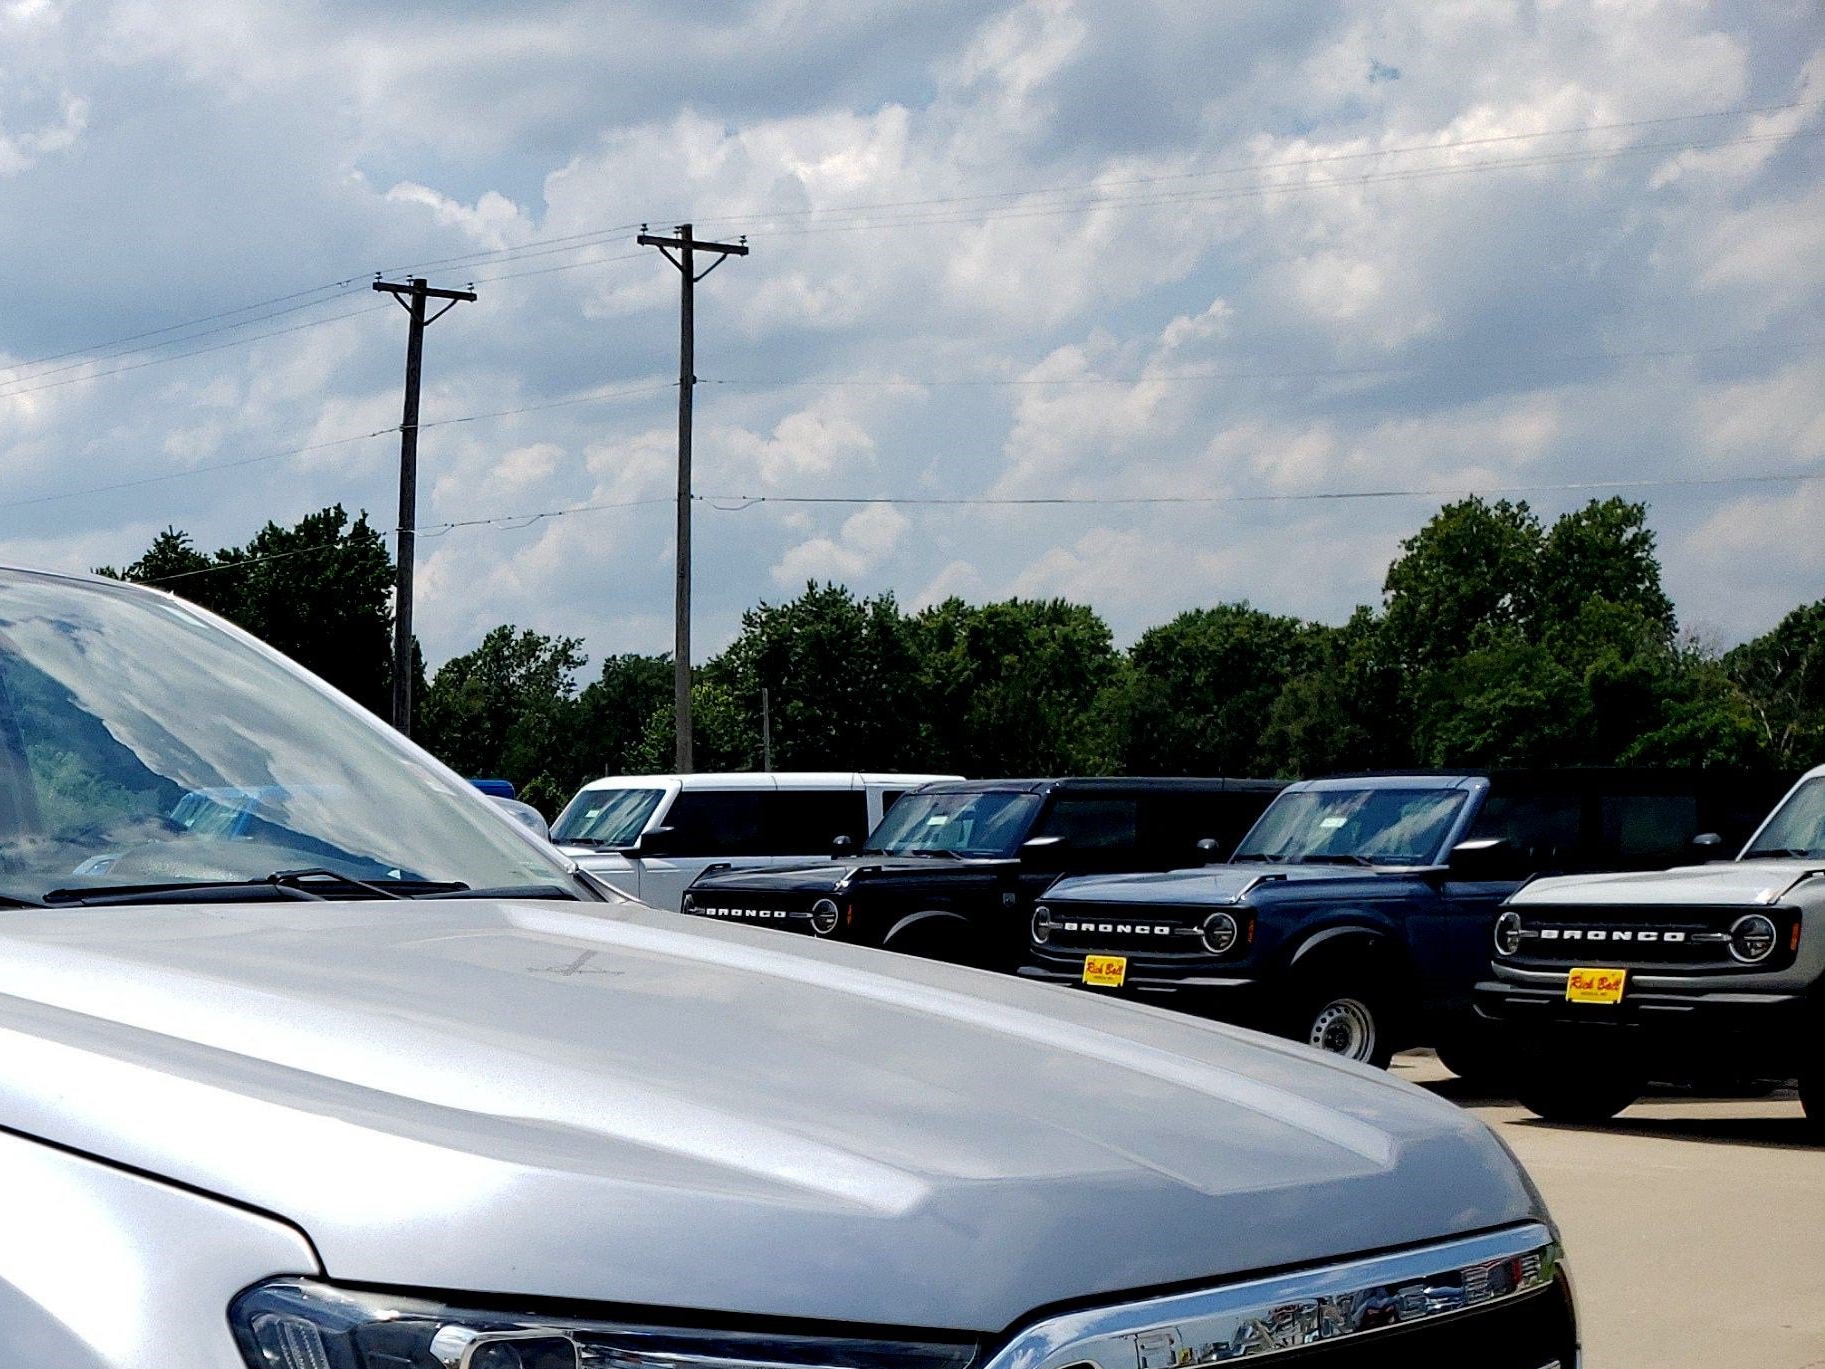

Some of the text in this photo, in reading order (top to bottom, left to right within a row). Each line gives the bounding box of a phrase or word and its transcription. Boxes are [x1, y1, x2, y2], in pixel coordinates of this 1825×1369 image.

[706, 908, 786, 918] BRONCO
[1064, 922, 1170, 935] BRONCO
[1540, 929, 1685, 942] BRONCO
